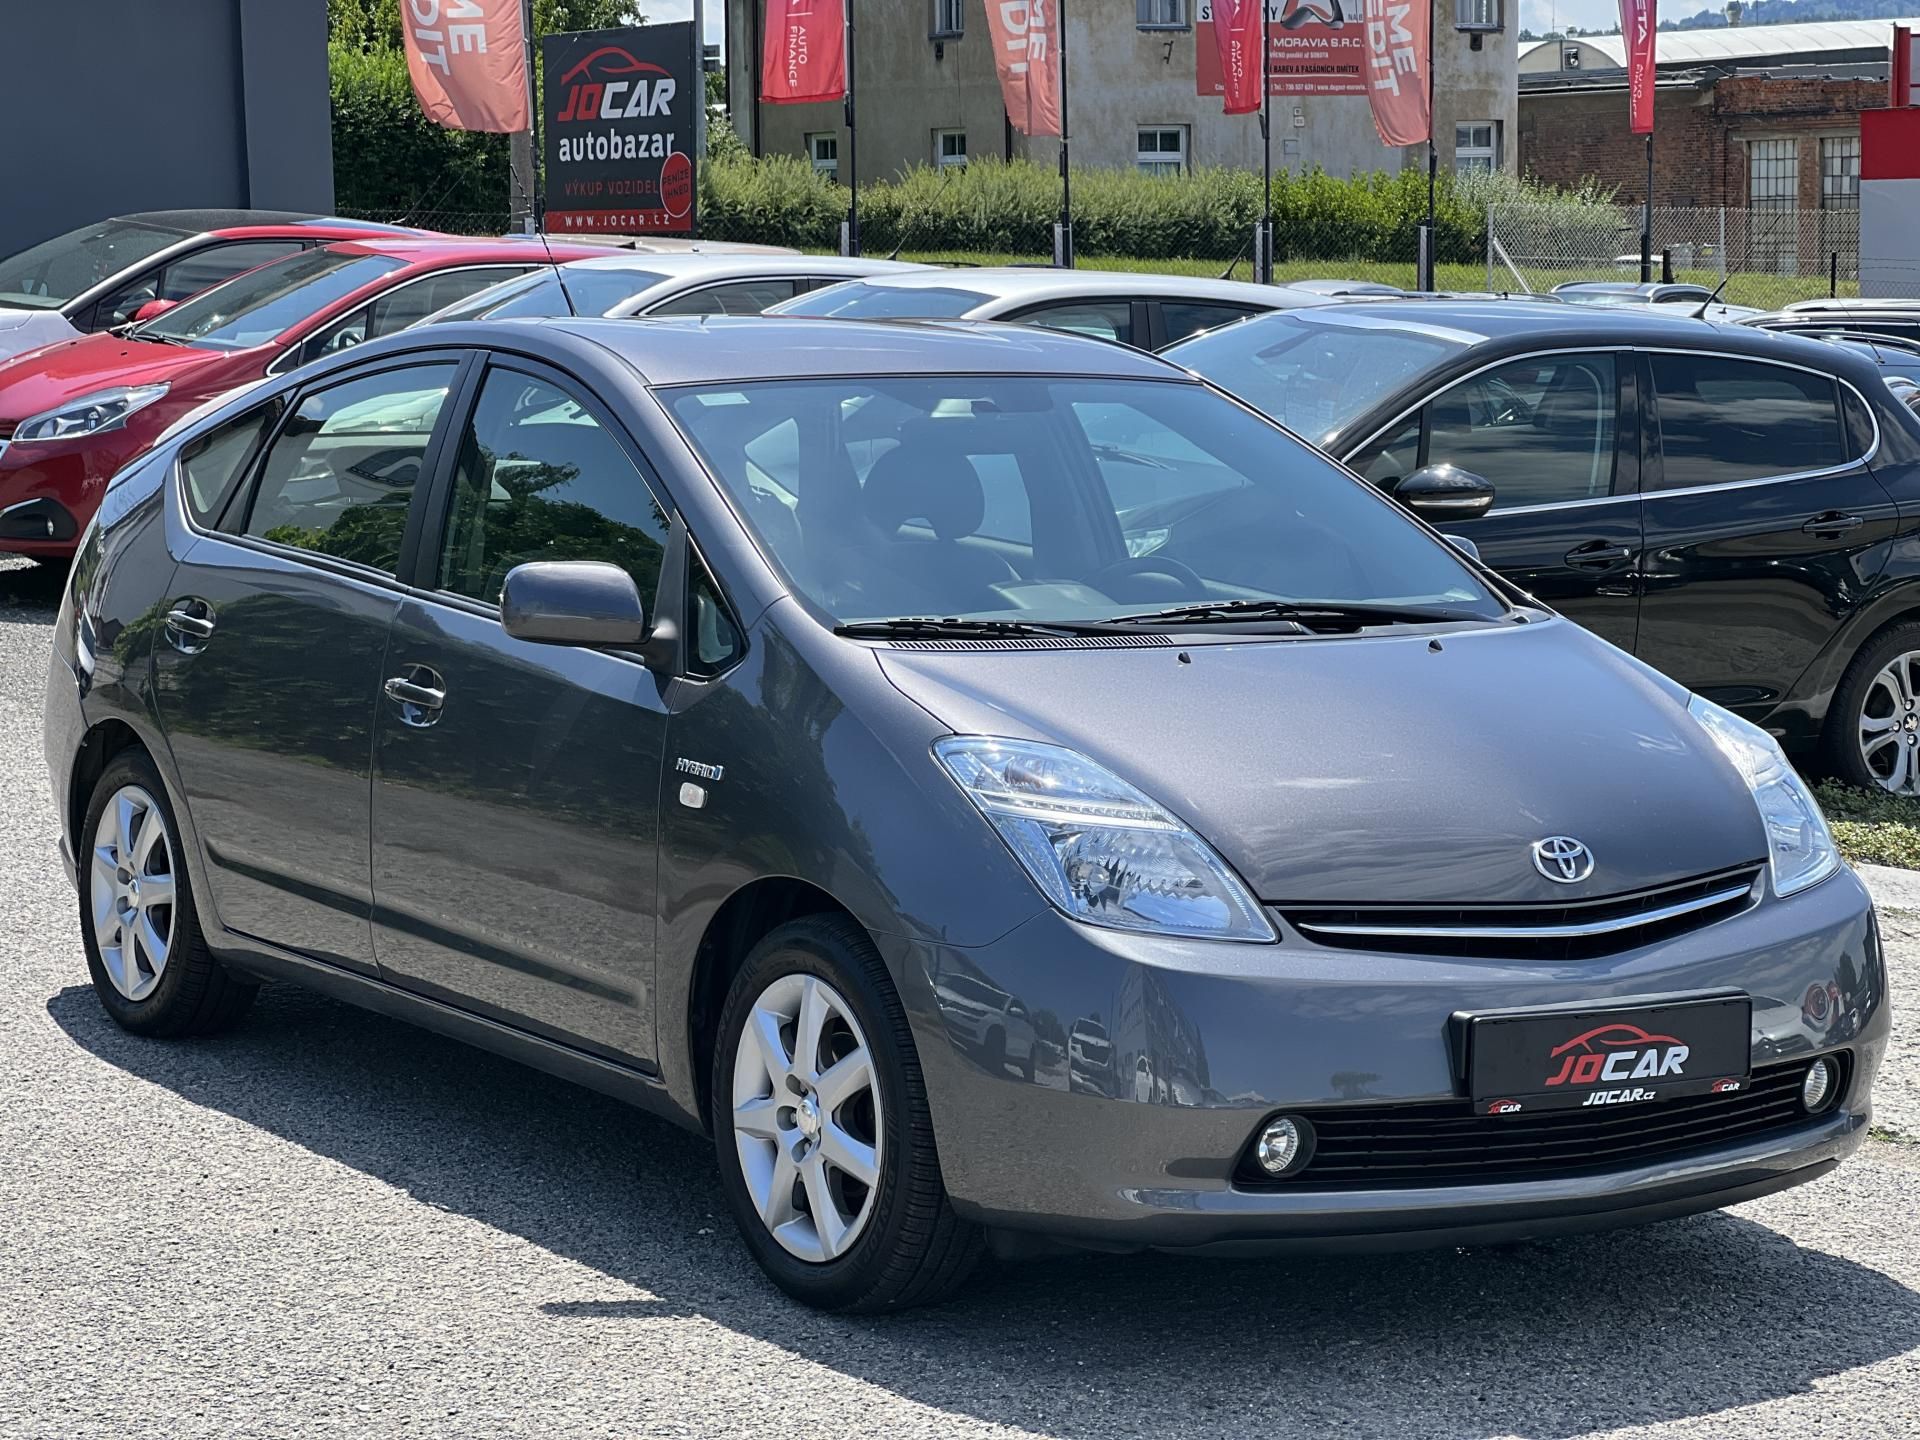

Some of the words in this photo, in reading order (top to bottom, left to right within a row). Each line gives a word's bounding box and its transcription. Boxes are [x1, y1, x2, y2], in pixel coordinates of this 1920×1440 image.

[798, 25, 808, 64] AUTO
[1273, 38, 1329, 48] MORAVIA
[1386, 0, 1417, 75] ME
[788, 25, 798, 88] FINANCE
[1235, 40, 1243, 78] AUTO
[1273, 65, 1294, 73] BAREV
[1295, 65, 1300, 73] A
[1301, 63, 1335, 73] FASÁDNÍCH
[1336, 64, 1360, 73] OMÍTEK
[557, 78, 677, 122] JOCAR
[559, 128, 675, 162] autobazar
[565, 179, 603, 197] VÝKUP
[607, 179, 659, 195] VOZIDEL
[564, 214, 670, 228] WWW.JOCAR.CZ
[675, 757, 721, 780] HYBRID
[1544, 1045, 1690, 1086] JOCAR
[1711, 1082, 1741, 1092] JOCAR
[1487, 1103, 1522, 1114] JOCAR
